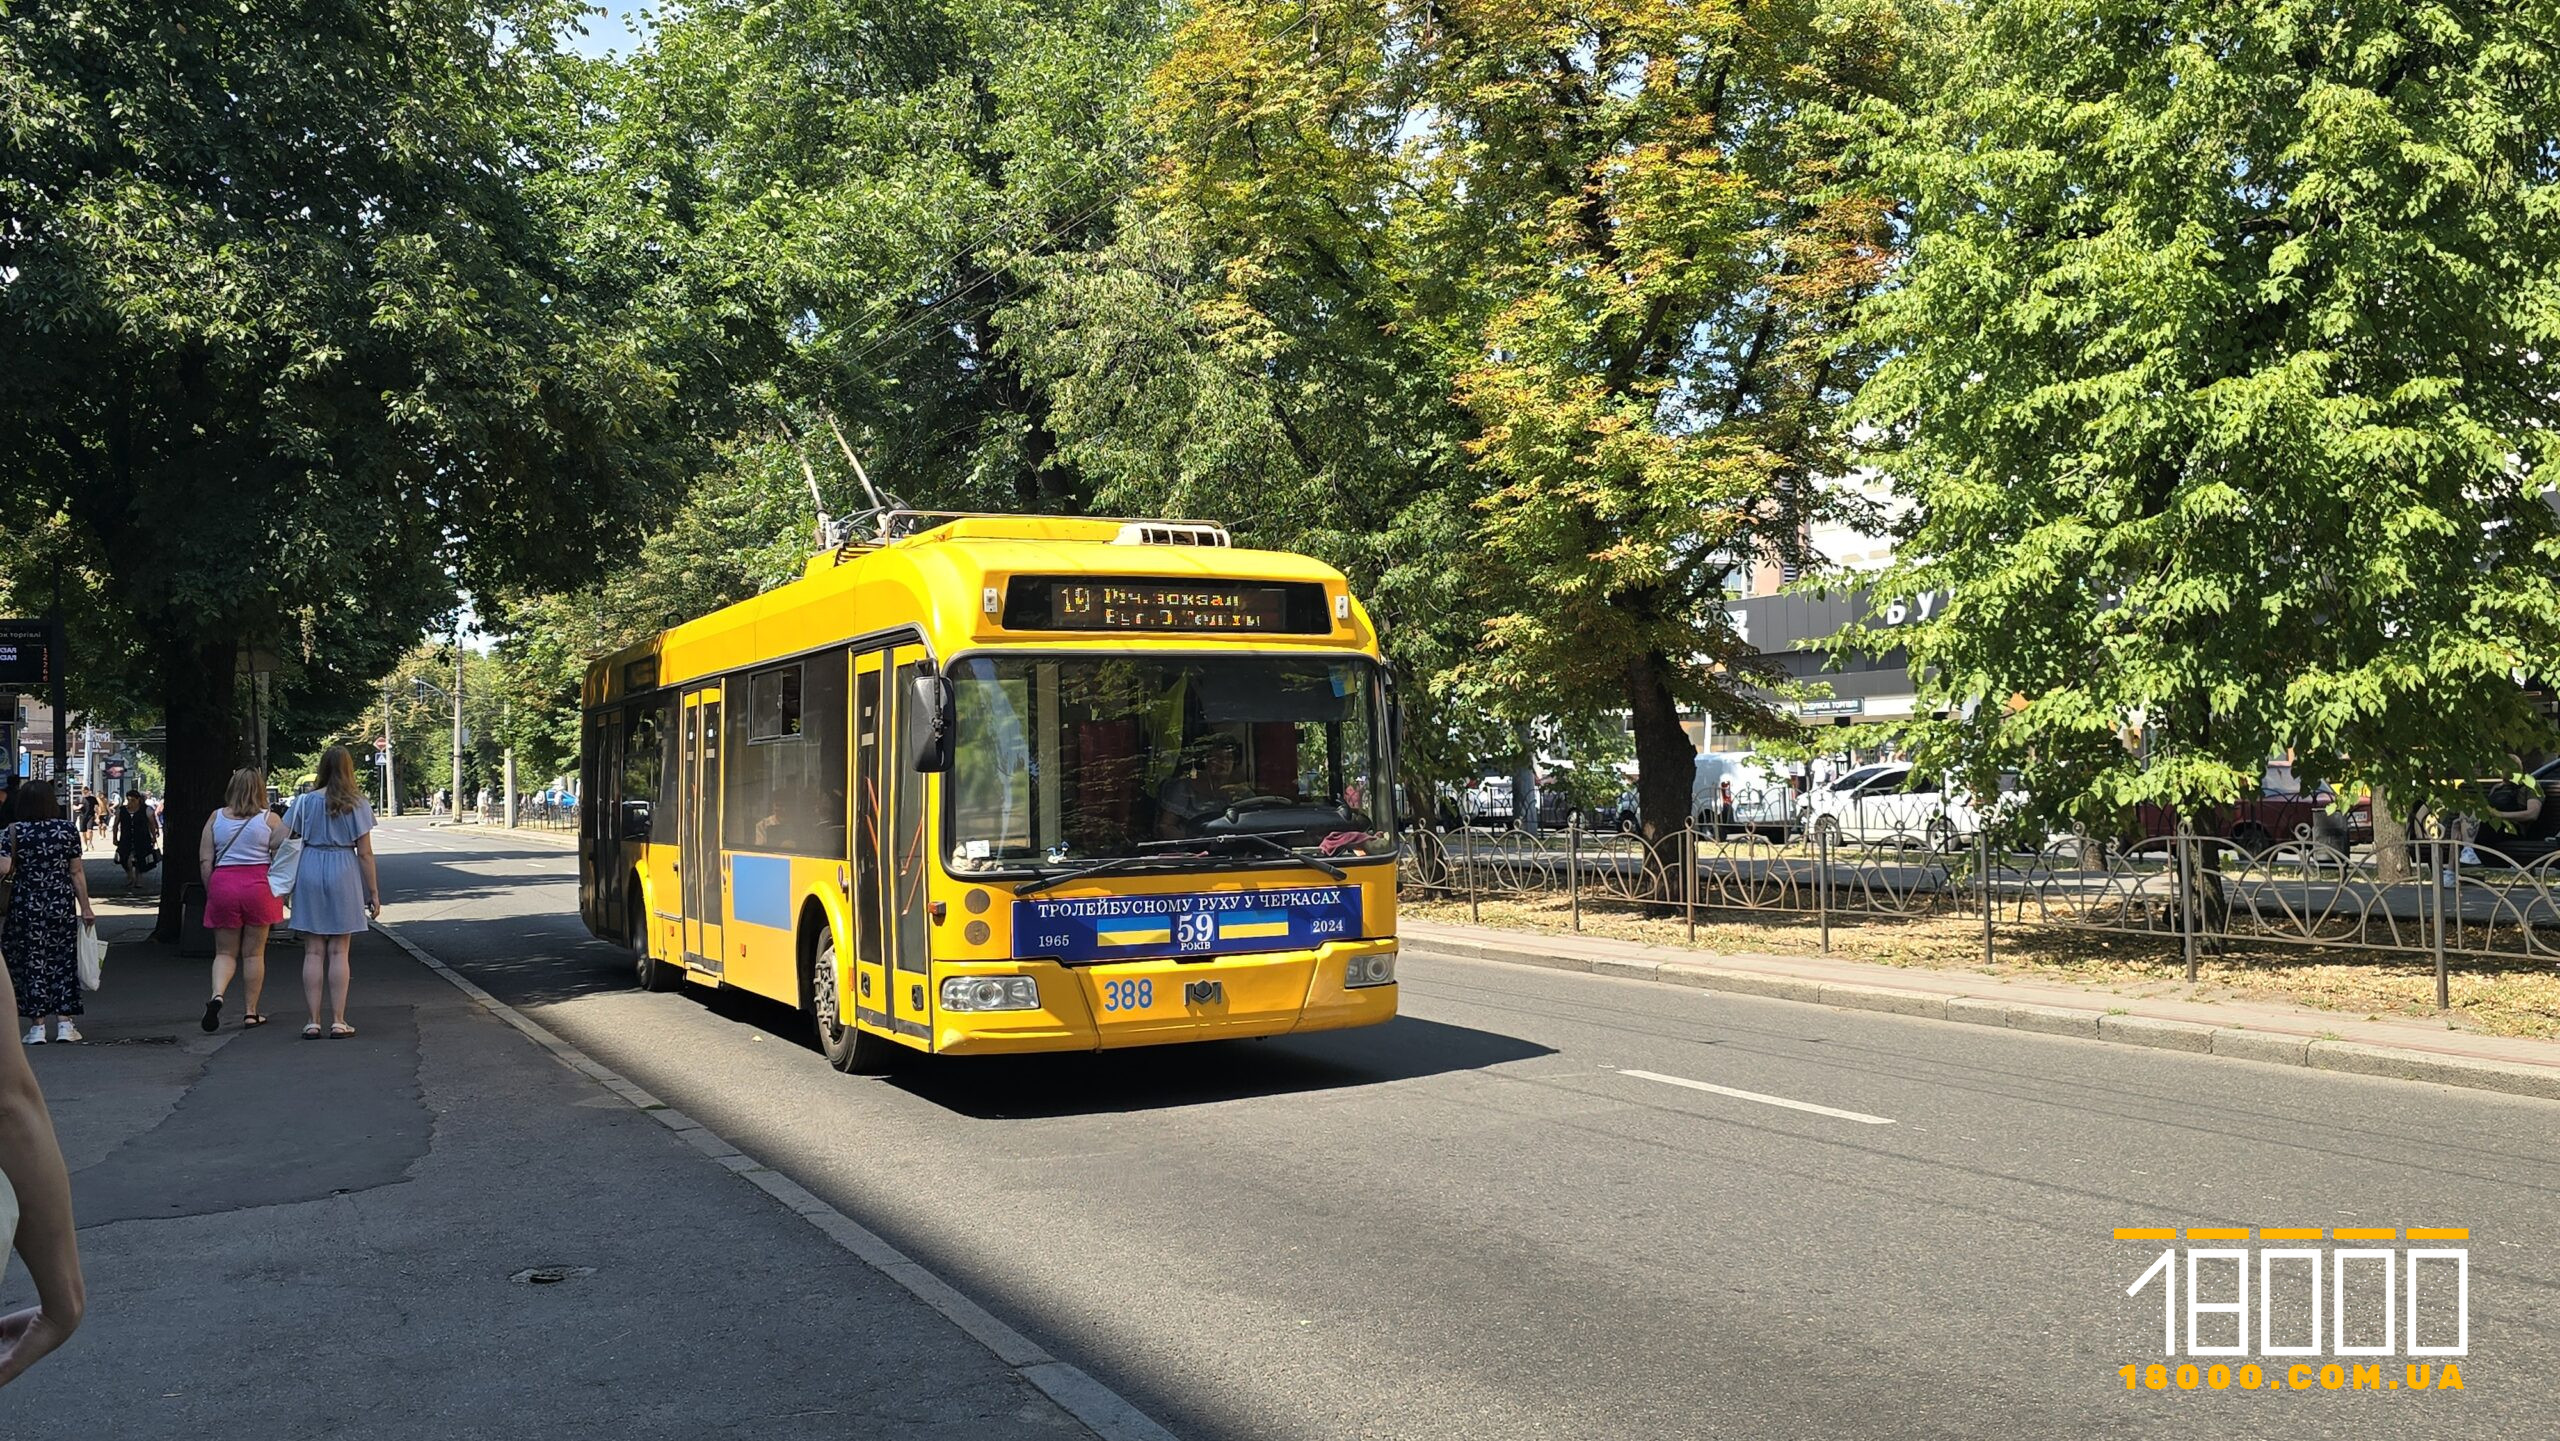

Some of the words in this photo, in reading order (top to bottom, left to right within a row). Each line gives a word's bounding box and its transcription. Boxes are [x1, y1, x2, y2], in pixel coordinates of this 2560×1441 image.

[1038, 898, 1193, 918] ТРОЛЕЙБУСНОМУ
[1199, 896, 1240, 911] РУХУ
[1244, 895, 1255, 908] У
[1259, 891, 1341, 908] ЧЕРКАСАХ
[1177, 913, 1214, 943] 59
[1312, 919, 1344, 933] 2024
[1038, 934, 1070, 948] 1965
[1180, 941, 1211, 951] РОКІВ
[1104, 978, 1153, 1012] 388
